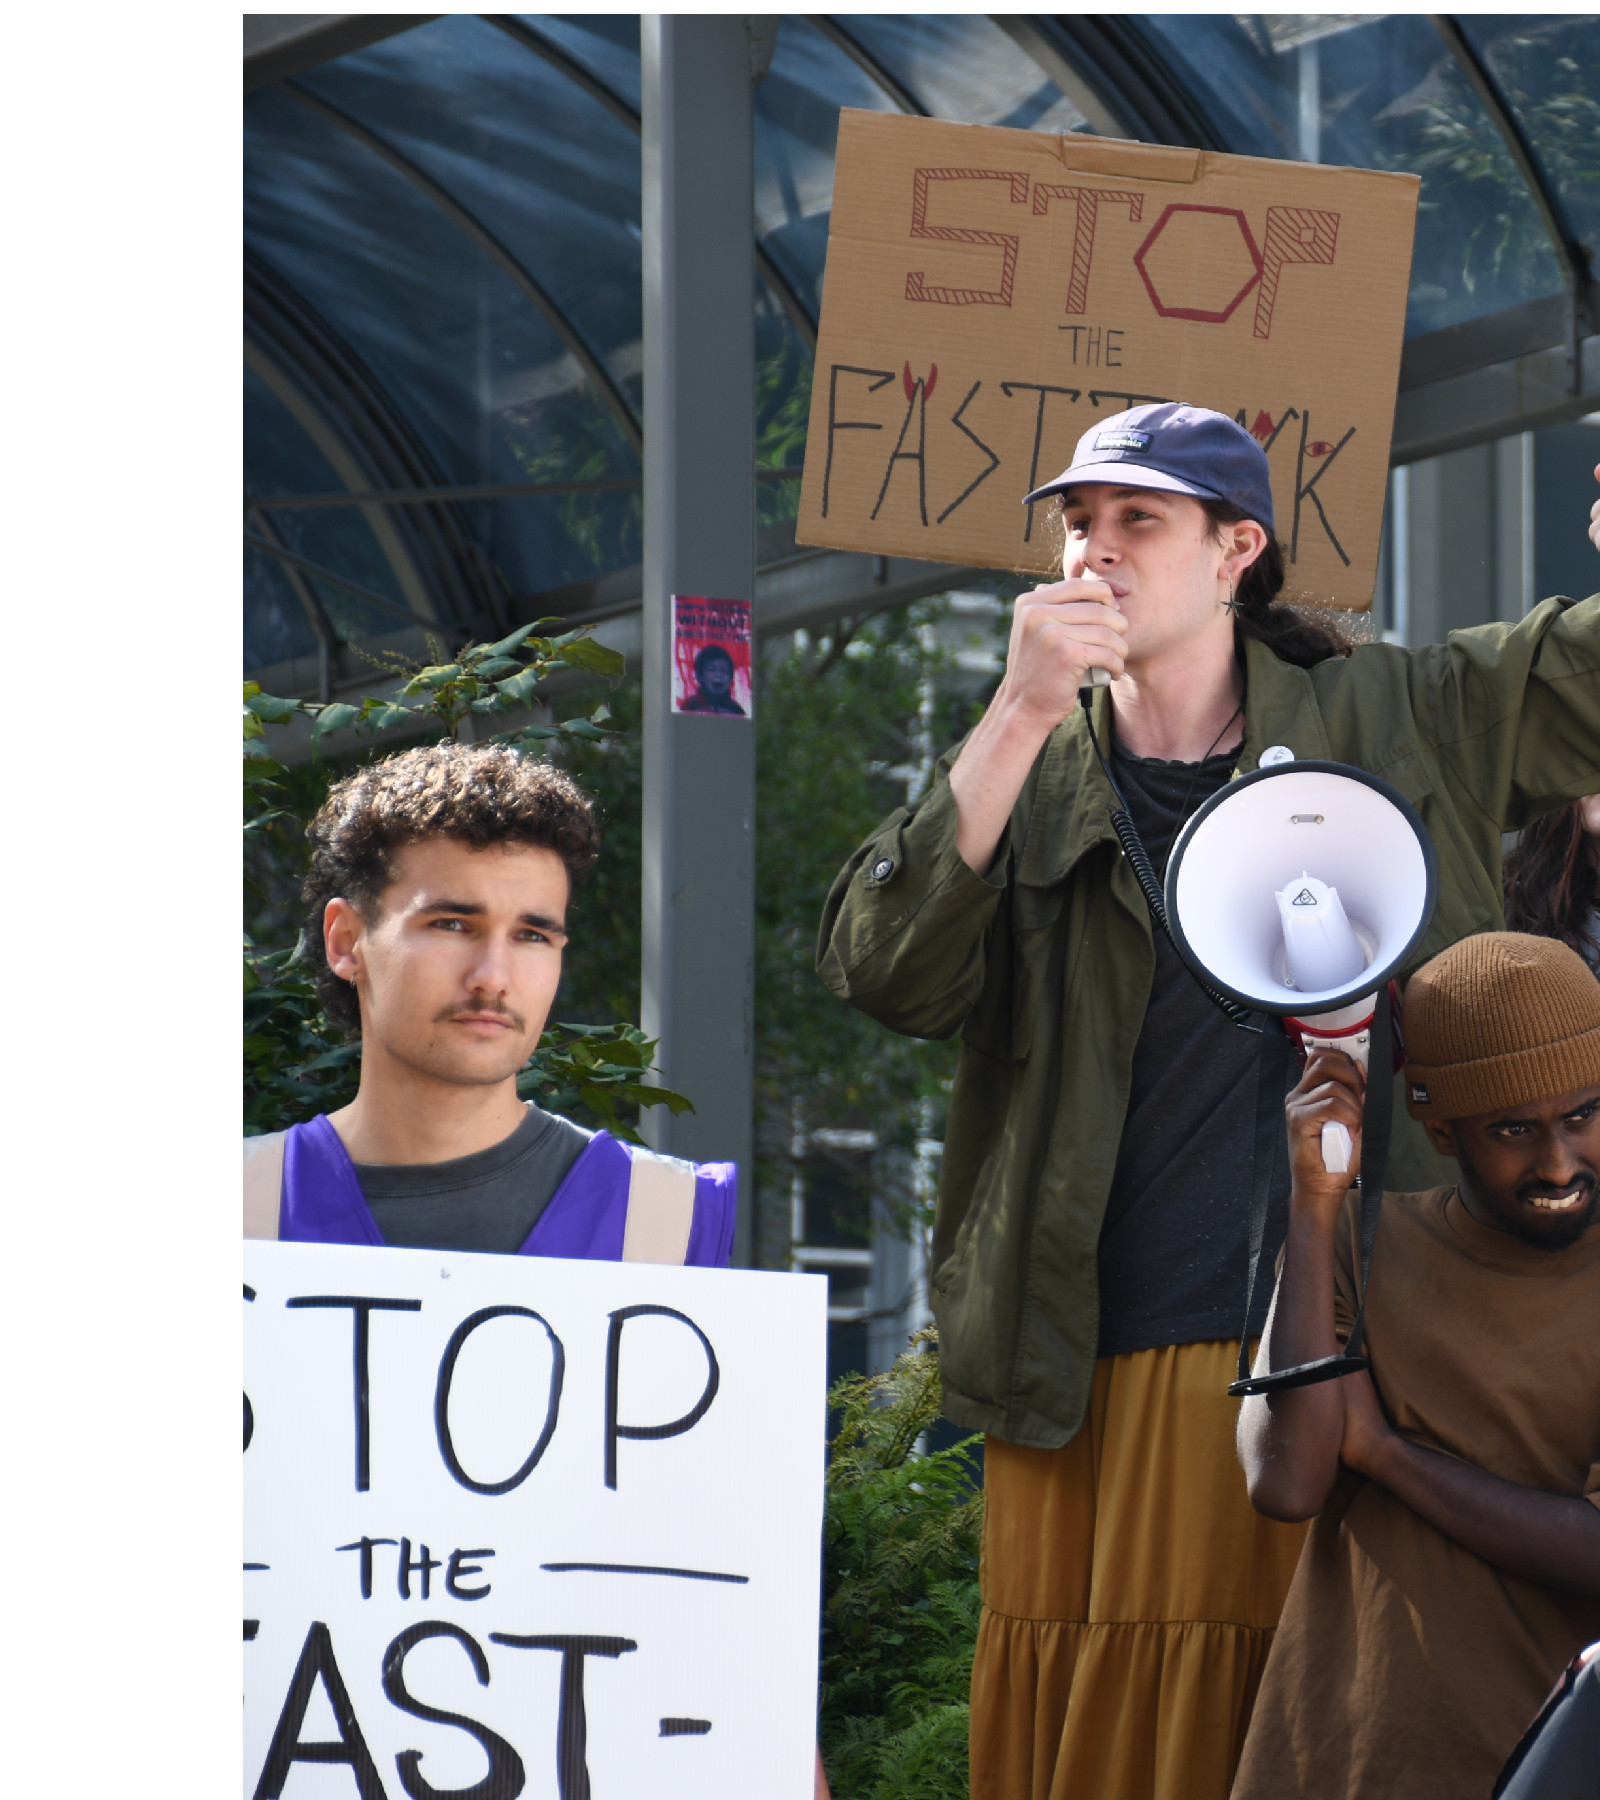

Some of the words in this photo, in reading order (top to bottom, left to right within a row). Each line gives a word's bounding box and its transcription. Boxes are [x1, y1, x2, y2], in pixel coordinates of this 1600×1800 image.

[905, 167, 1342, 340] STOP
[1058, 326, 1124, 367] THE
[243, 1283, 719, 1495] TOP
[335, 1536, 496, 1600] THE
[243, 1620, 712, 1799] AST-
